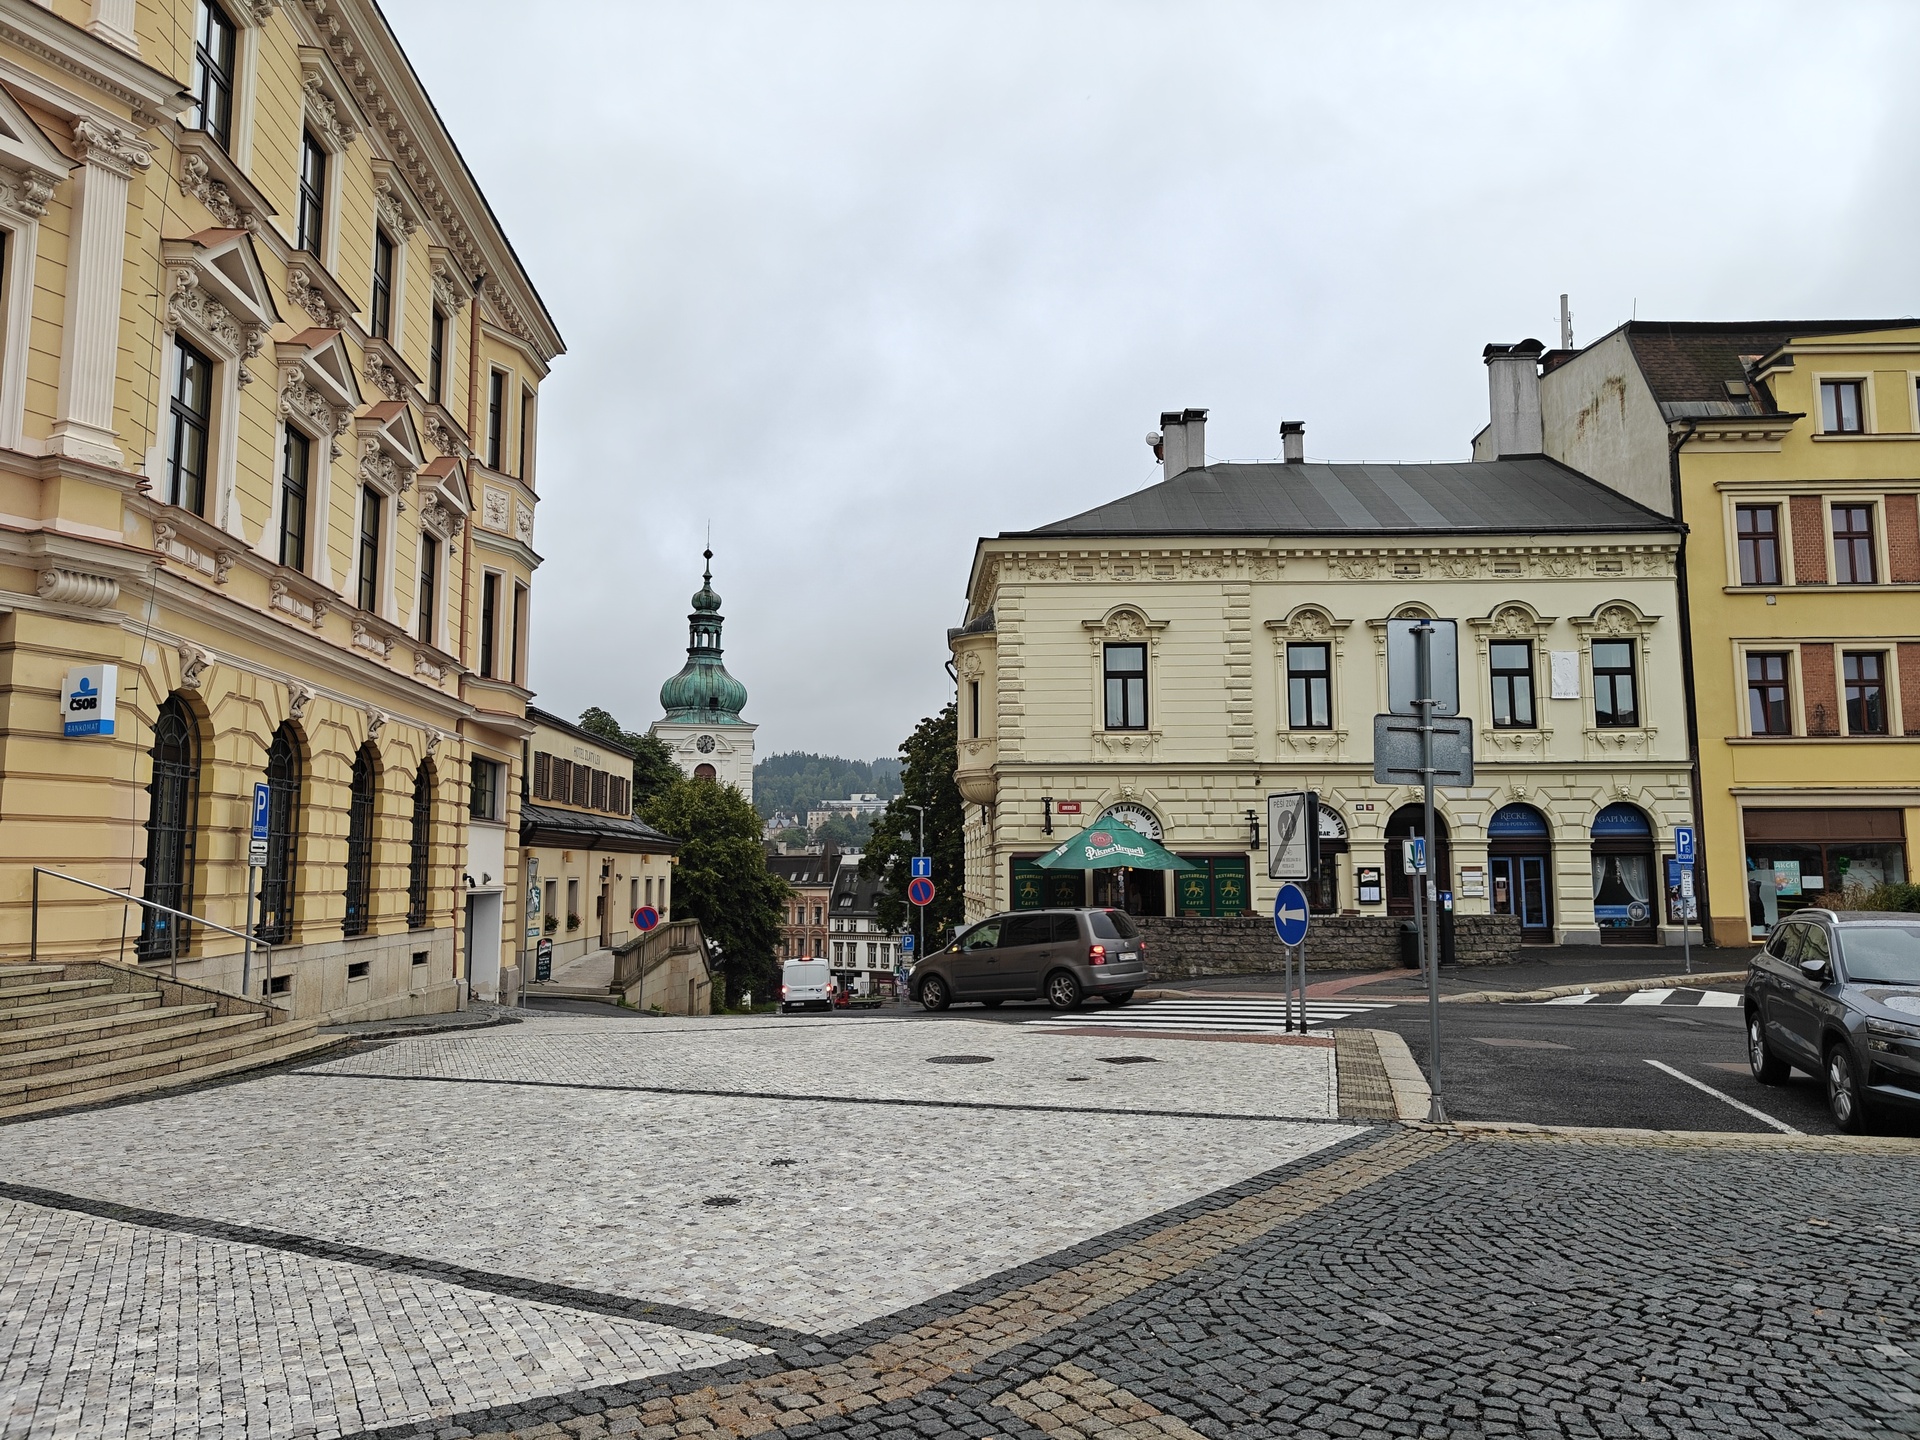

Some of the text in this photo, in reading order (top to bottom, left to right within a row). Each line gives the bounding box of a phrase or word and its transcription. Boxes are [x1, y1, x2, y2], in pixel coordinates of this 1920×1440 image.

[69, 697, 97, 711] ČSOB
[67, 723, 99, 732] BANKOMAT
[256, 791, 266, 821] P
[1500, 811, 1527, 821] RECKE
[1618, 814, 1638, 824] MOU
[1679, 831, 1691, 852] P
[1085, 846, 1116, 860] Pilsner
[1114, 844, 1145, 857] Urquell
[904, 937, 912, 946] P
